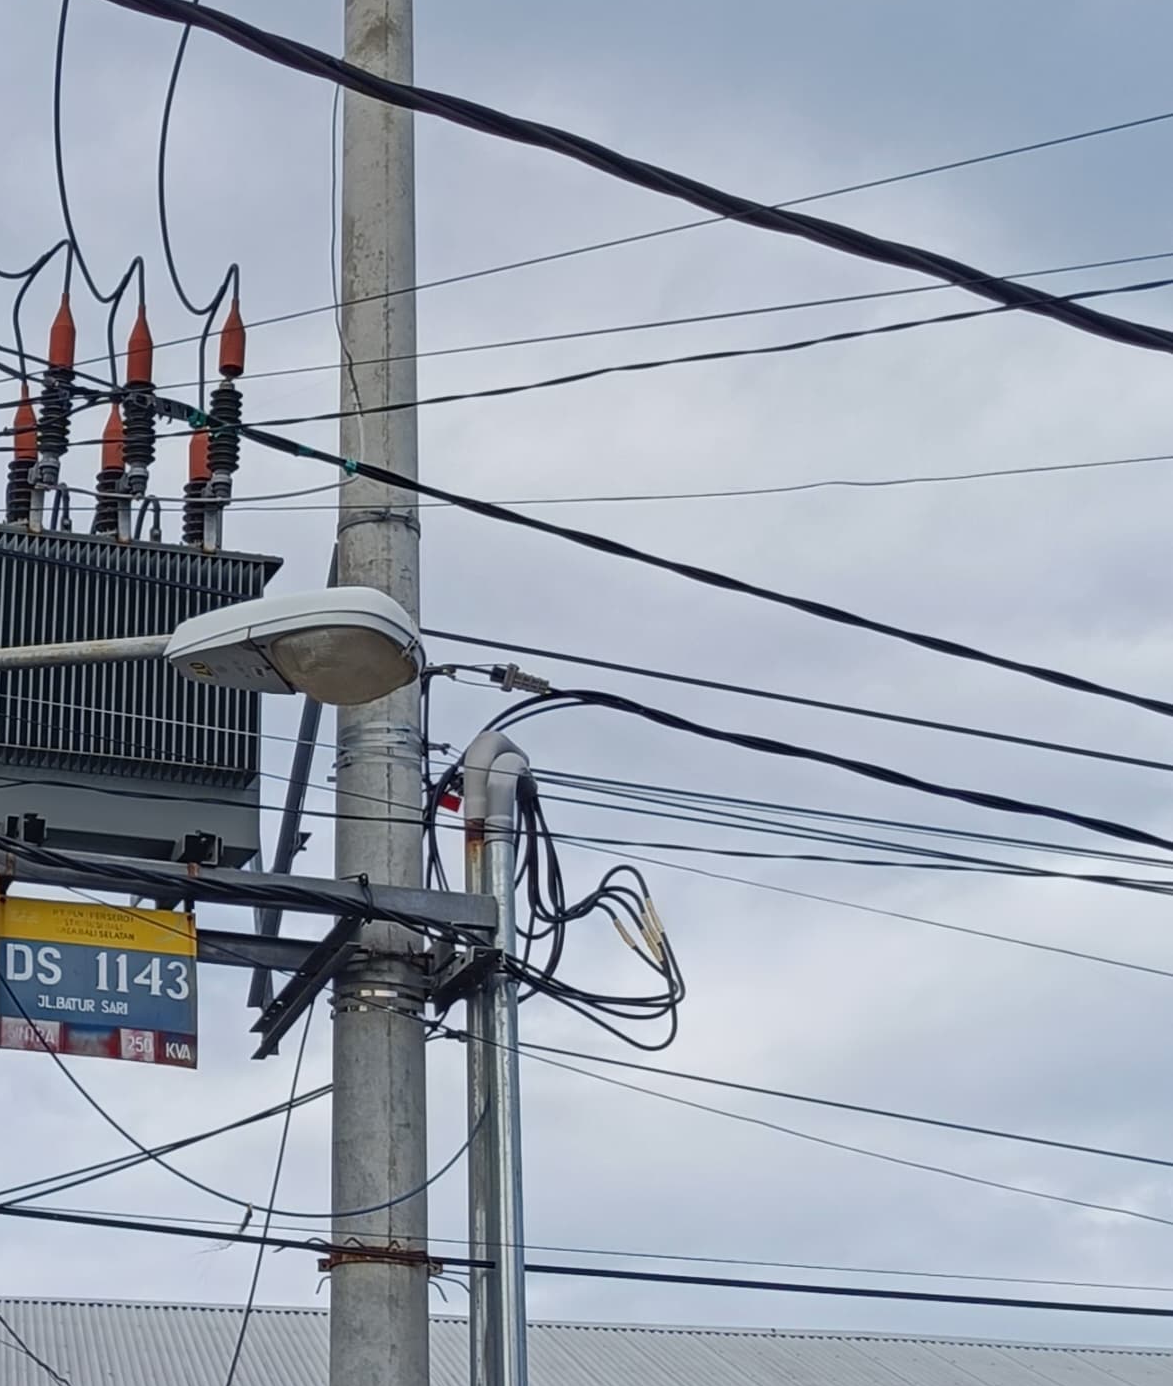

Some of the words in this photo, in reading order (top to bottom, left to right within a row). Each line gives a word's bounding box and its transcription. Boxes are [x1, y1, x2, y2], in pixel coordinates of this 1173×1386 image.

[5, 942, 62, 986] DS
[96, 951, 190, 1000] 1143
[37, 994, 95, 1012] JL.BATUR
[101, 1000, 128, 1015] SARI
[127, 1035, 153, 1054] 250
[165, 1041, 192, 1061] KVA
